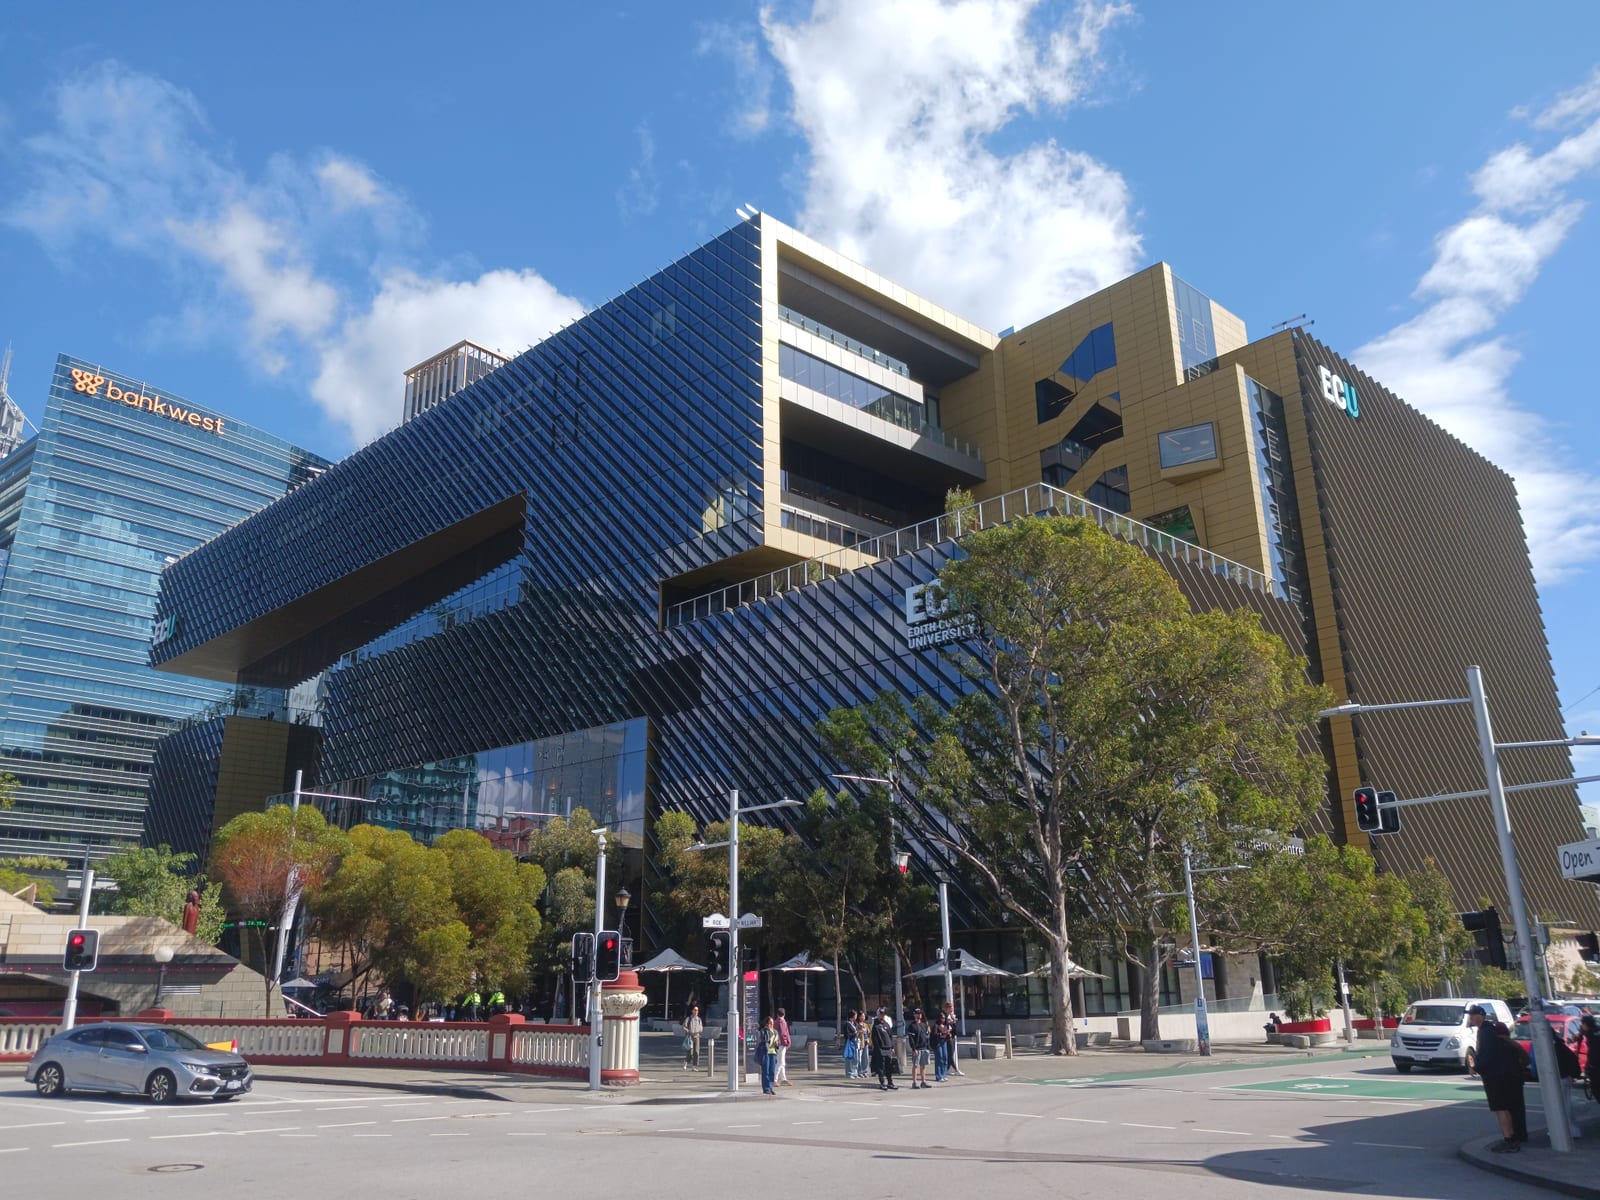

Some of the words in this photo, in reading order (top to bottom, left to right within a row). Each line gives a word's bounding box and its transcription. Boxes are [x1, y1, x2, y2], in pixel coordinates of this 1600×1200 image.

[106, 380, 225, 435] bankwest
[1318, 364, 1360, 419] ECU
[153, 614, 177, 646] ECU
[907, 622, 937, 638] EDITH
[1562, 850, 1594, 876] Open
